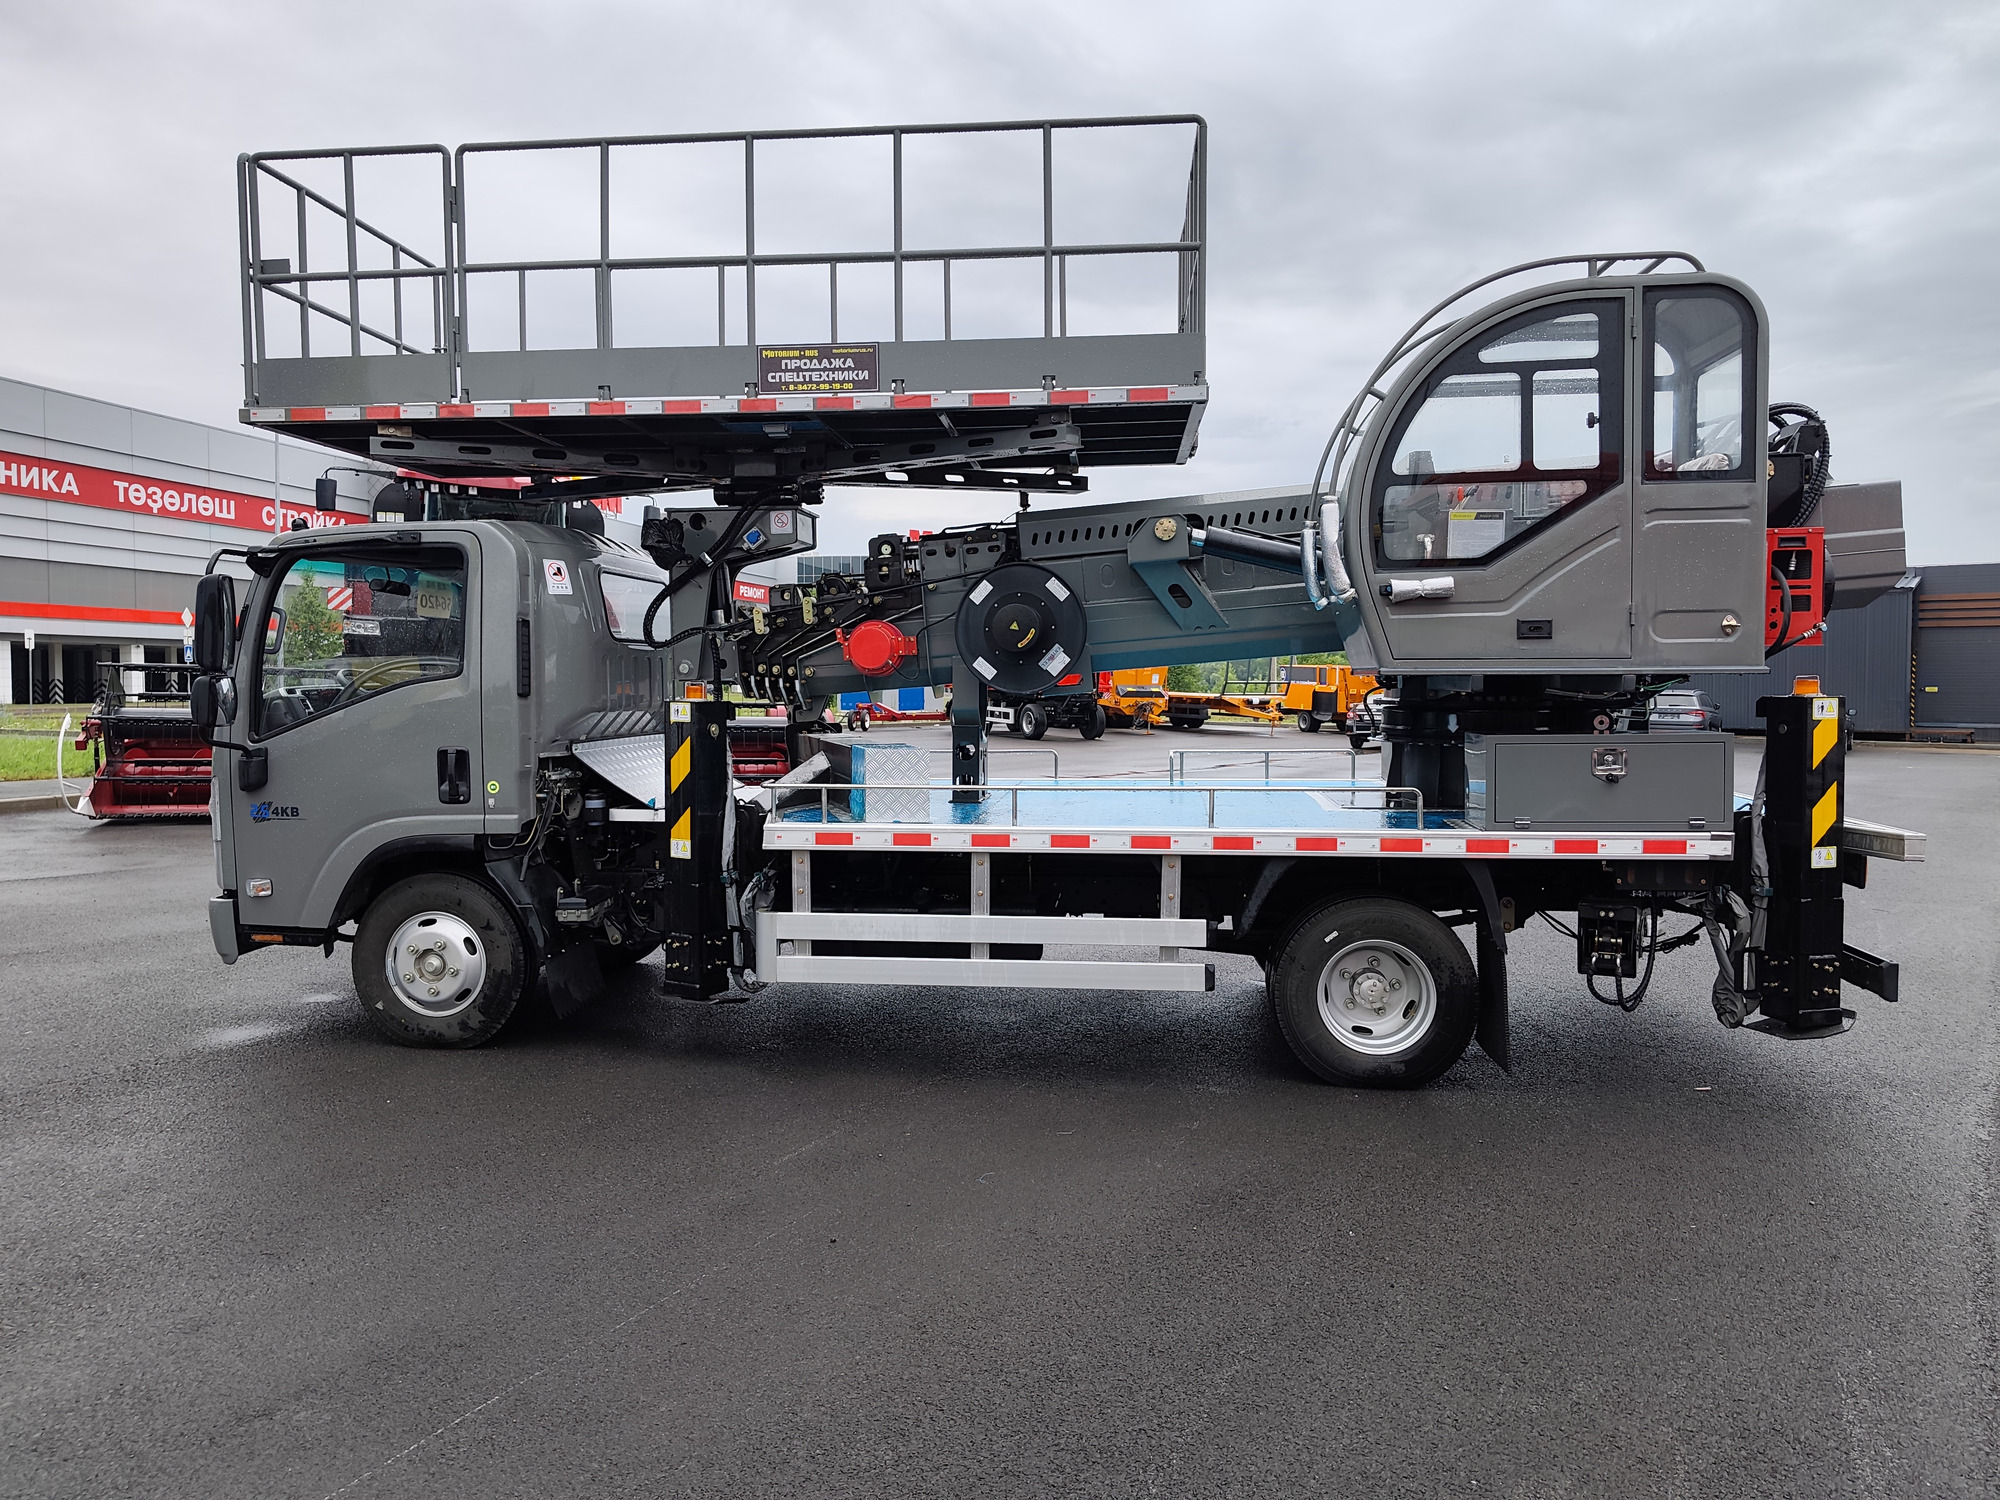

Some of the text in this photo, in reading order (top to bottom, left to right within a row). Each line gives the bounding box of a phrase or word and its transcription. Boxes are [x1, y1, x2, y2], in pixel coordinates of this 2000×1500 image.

[804, 349, 819, 357] RUS
[781, 358, 855, 370] ПРОДАЖА
[767, 370, 869, 383] СПЕЦТЕХНИКИ
[788, 383, 853, 391] 8-3472-99-19-00
[0, 461, 80, 496] НИКА
[739, 585, 765, 600] РЕМОНТ
[271, 806, 300, 817] 4KB
